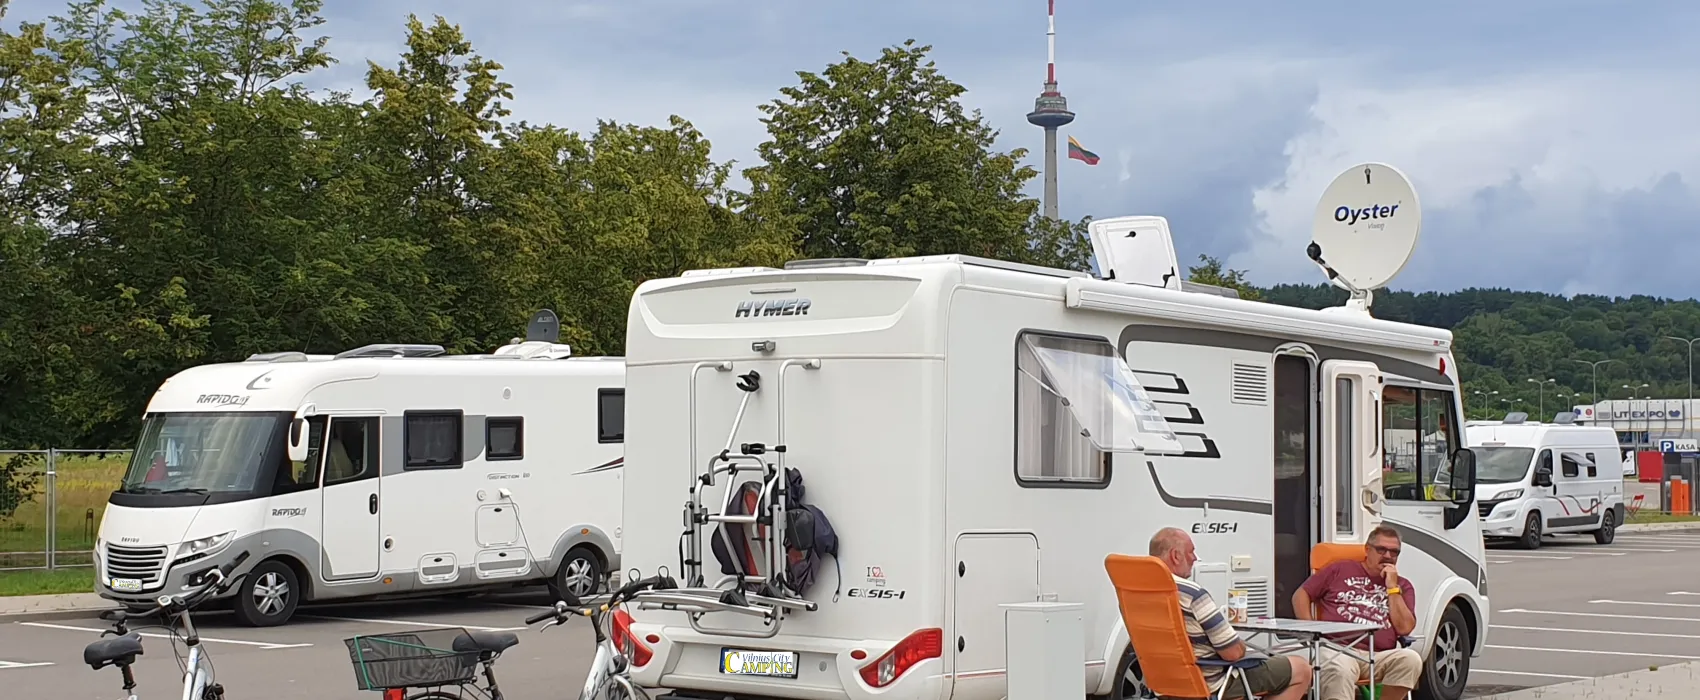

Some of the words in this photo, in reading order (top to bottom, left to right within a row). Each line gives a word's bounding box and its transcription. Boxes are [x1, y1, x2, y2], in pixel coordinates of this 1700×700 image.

[1334, 203, 1399, 226] Oyster
[735, 298, 812, 318] HYMER
[1191, 522, 1238, 534] EXSIS-I
[847, 588, 906, 600] EXSIS-I
